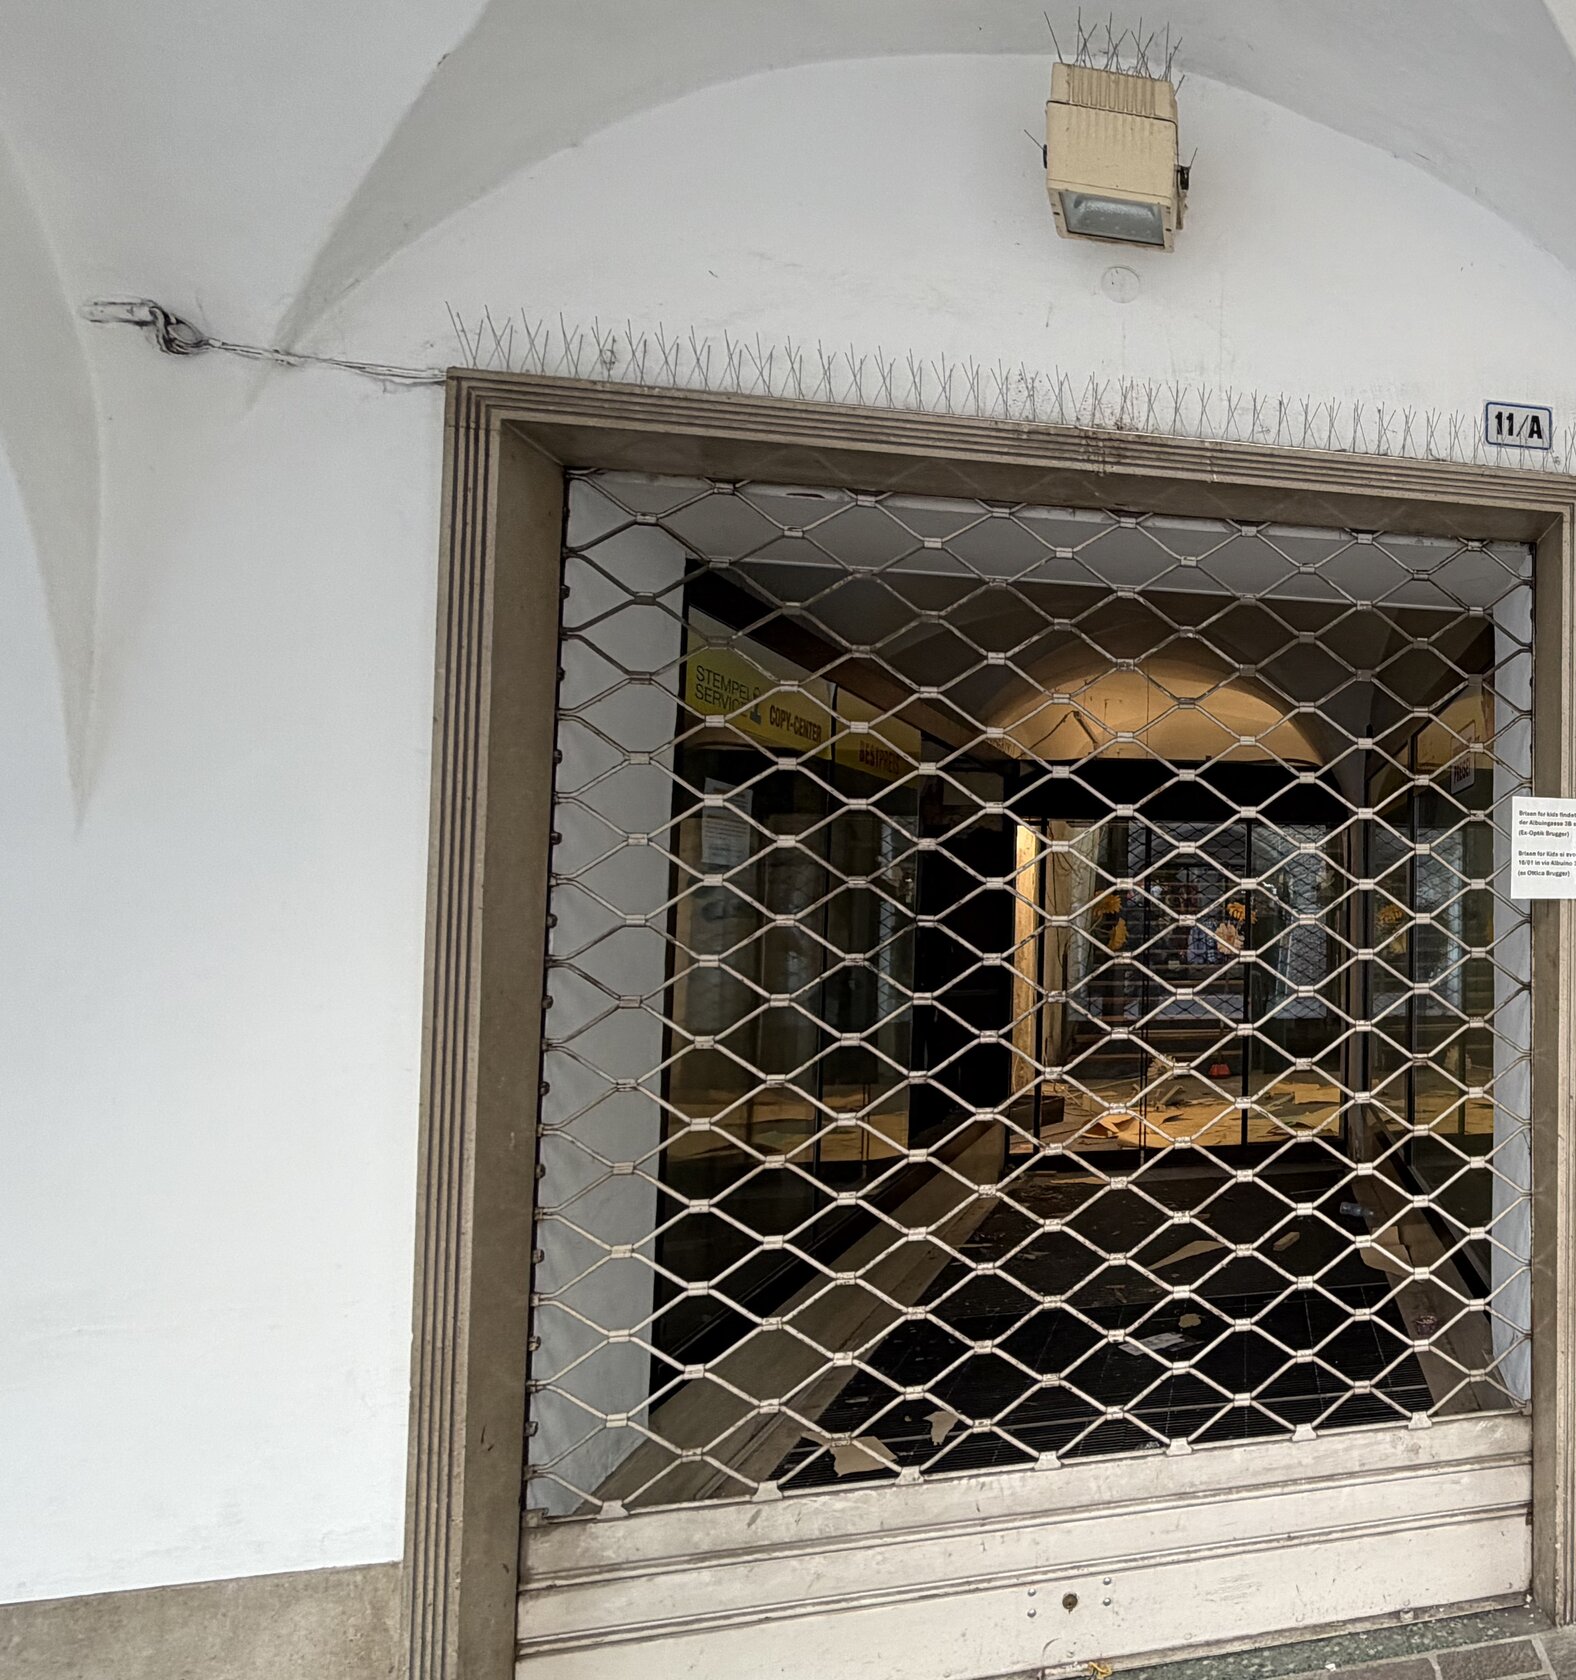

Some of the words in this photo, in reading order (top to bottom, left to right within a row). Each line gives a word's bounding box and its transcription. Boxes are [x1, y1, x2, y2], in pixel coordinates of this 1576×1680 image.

[1495, 411, 1542, 439] 11/A
[696, 665, 749, 700] STEMPEL
[769, 705, 822, 743] COPY-CENTER
